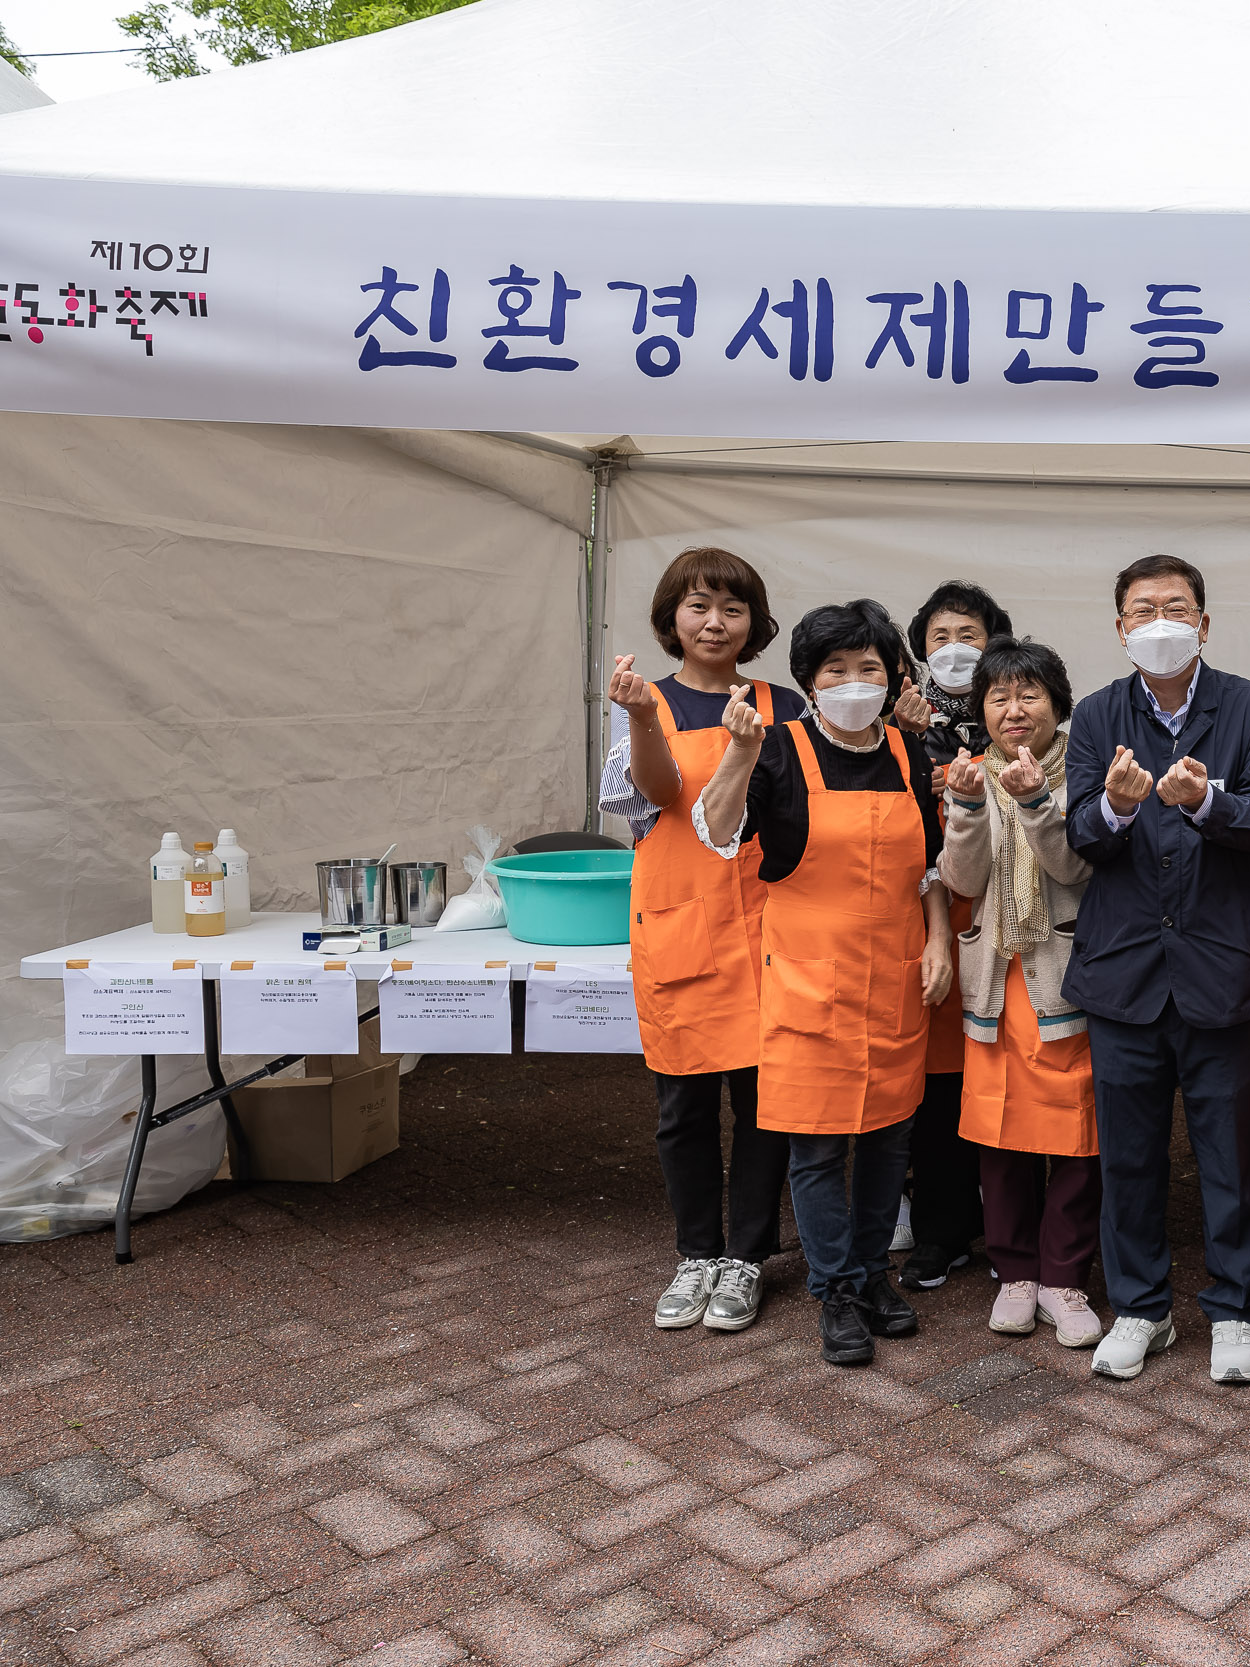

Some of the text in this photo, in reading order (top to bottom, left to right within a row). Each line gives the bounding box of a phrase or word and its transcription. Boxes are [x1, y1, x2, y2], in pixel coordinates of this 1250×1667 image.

[89, 239, 210, 274] 제10회
[0, 281, 209, 357] 동화축제
[110, 978, 154, 986] 과탄산나트륨
[265, 978, 280, 986] 맑은
[297, 978, 312, 986] 원액
